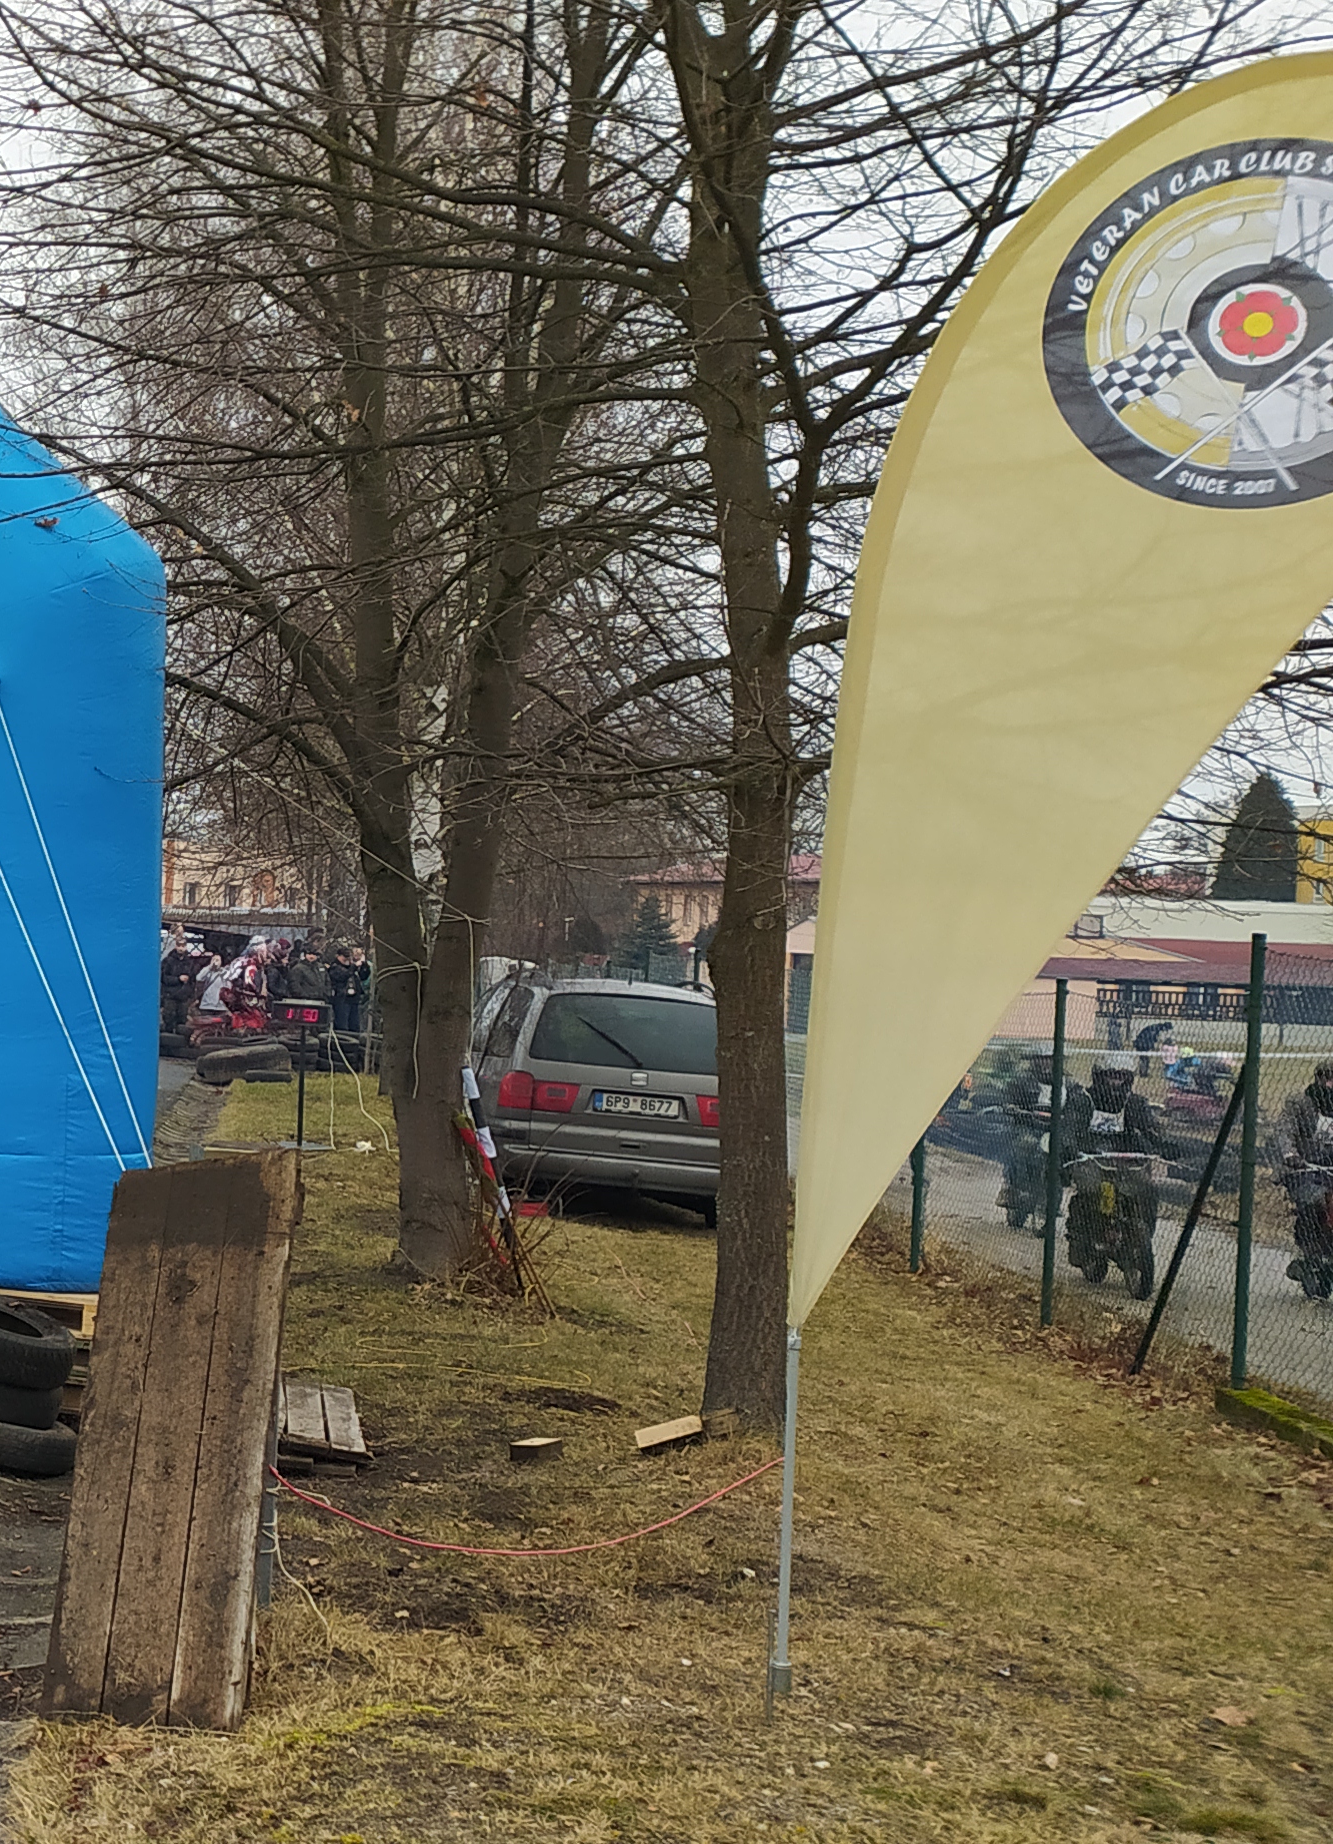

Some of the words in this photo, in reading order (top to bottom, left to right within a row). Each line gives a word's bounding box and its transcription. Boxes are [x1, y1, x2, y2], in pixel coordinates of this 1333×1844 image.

[1067, 186, 1161, 311] VETERAN
[1169, 158, 1232, 195] CAR
[1238, 150, 1317, 174] CLUB
[1175, 469, 1230, 495] SINCE
[605, 1095, 631, 1109] 6P9
[639, 1098, 673, 1113] 8677
